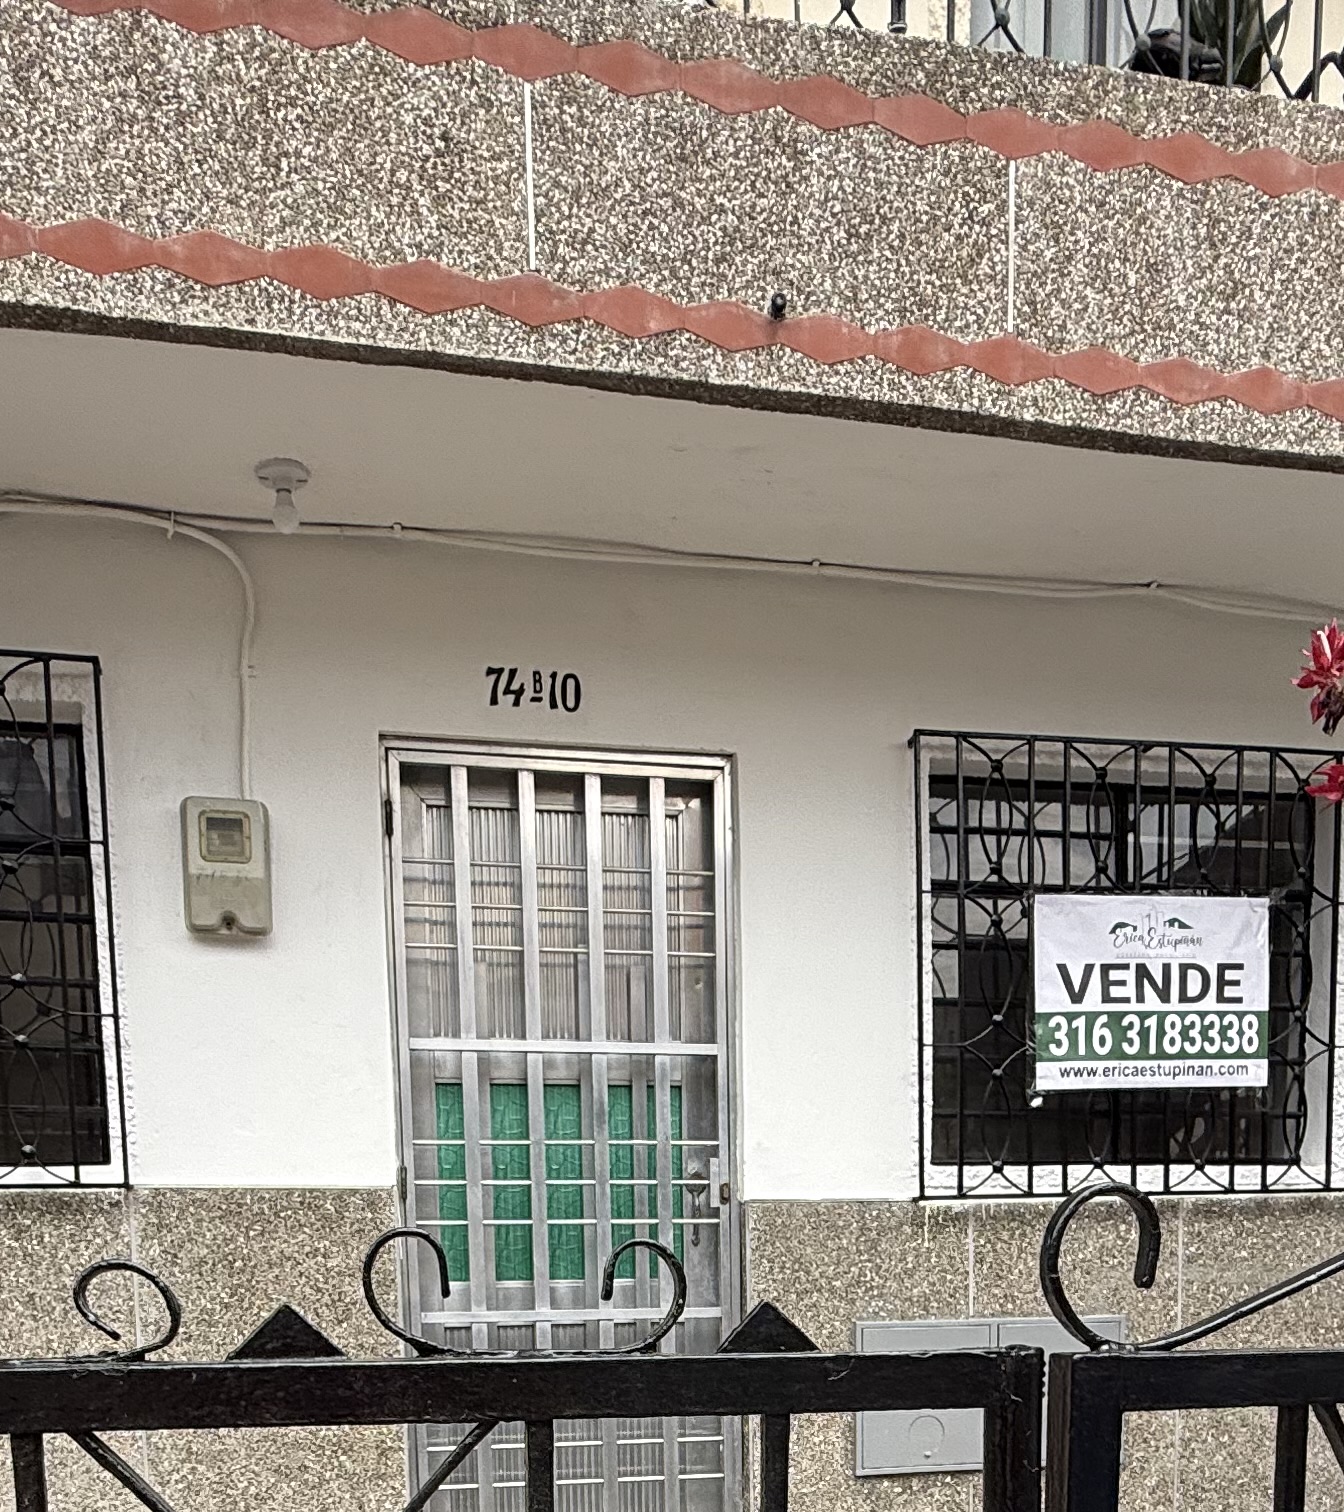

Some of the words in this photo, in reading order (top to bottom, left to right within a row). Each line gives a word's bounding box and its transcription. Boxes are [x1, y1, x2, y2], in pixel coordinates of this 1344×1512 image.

[1056, 962, 1245, 1005] VENDE
[1047, 1014, 1113, 1057] 316
[1121, 1013, 1260, 1055] 3183338
[1058, 1062, 1249, 1080] www.ericaestupinan.com
